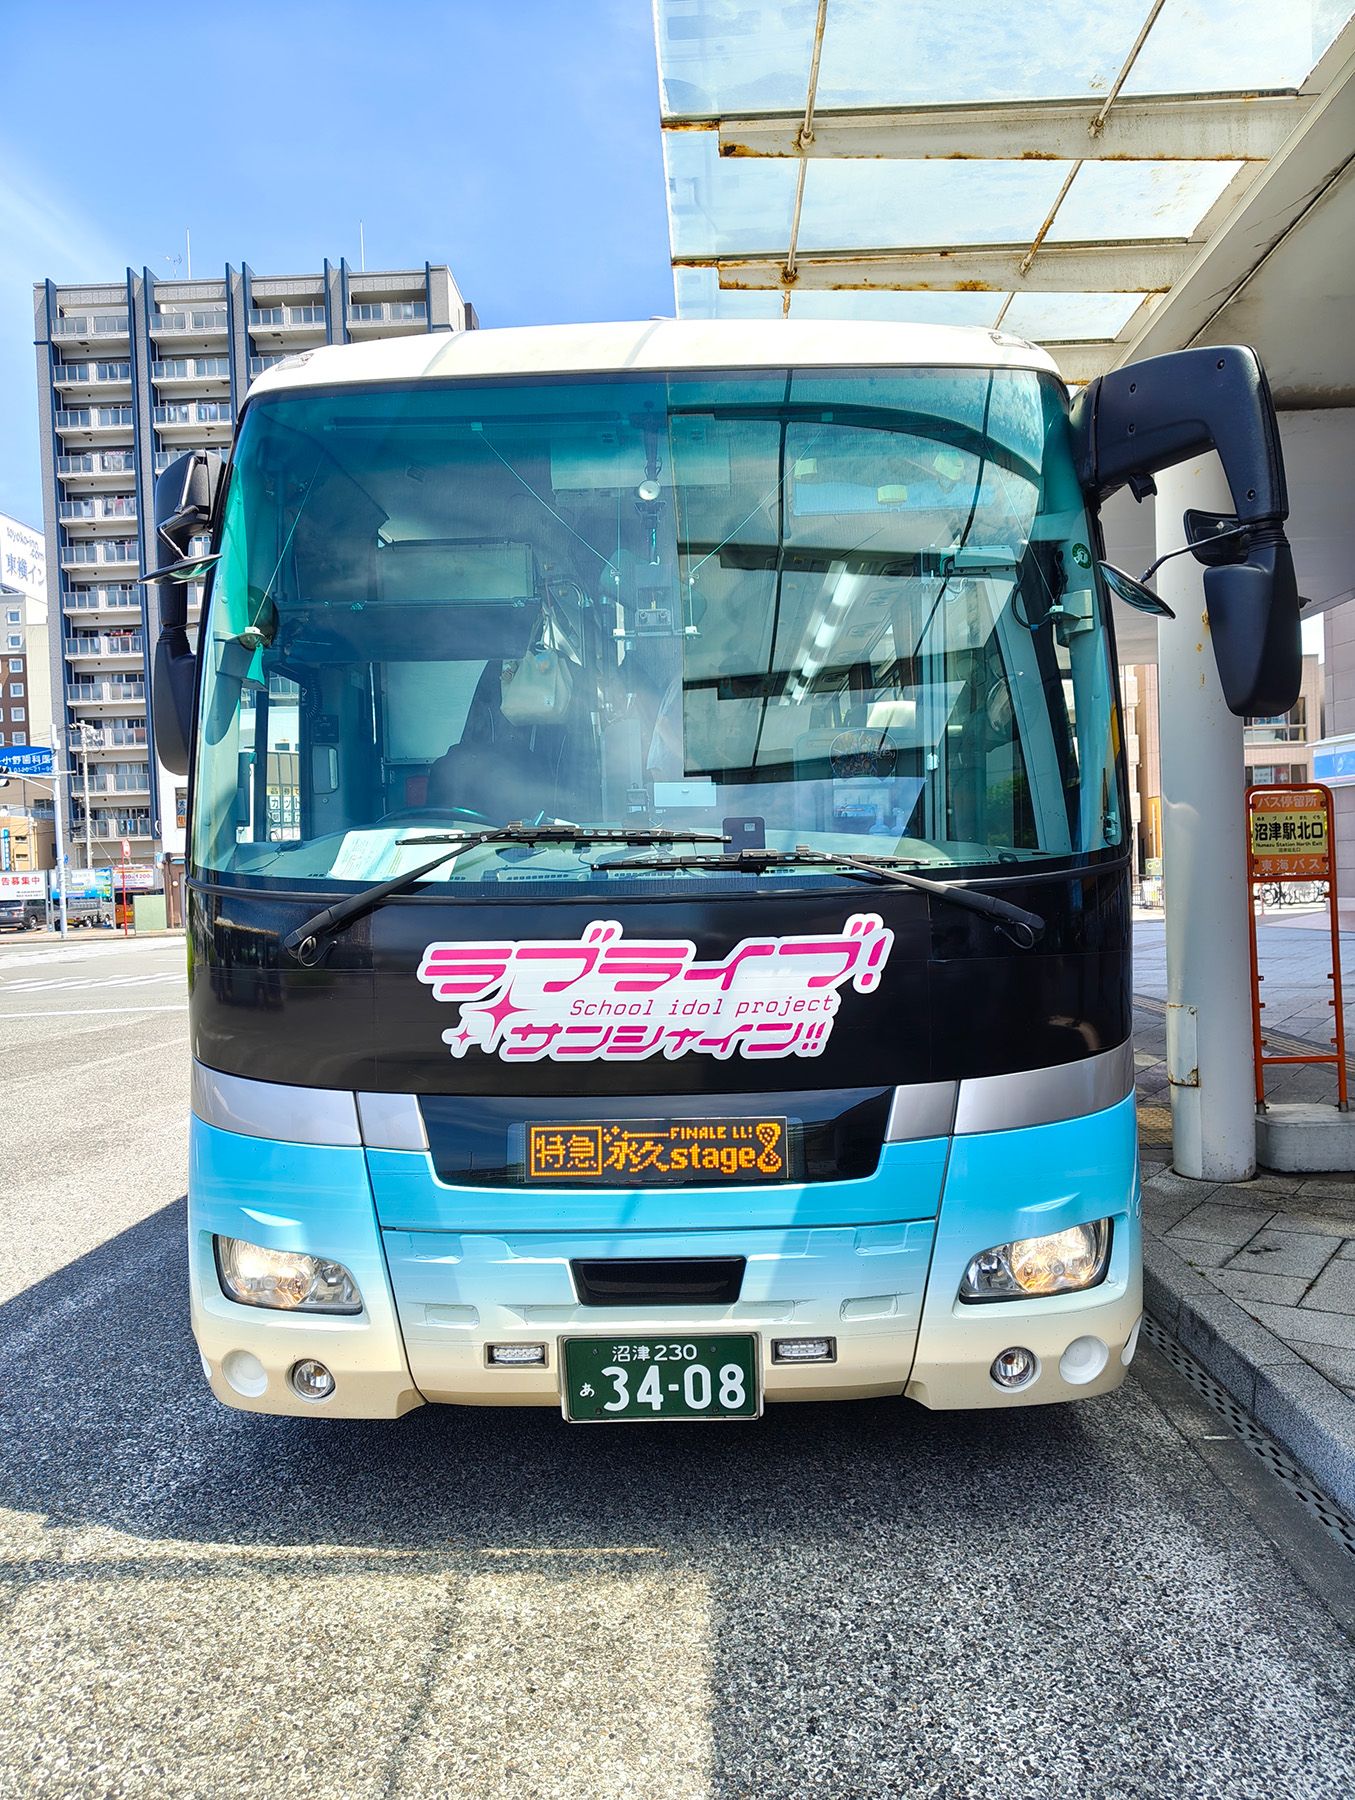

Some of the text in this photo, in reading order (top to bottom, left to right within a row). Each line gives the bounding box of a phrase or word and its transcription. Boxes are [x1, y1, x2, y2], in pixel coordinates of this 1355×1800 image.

[6, 553, 45, 586] 東横イン
[1257, 794, 1318, 808] バス停留所
[1255, 821, 1323, 841] 沼津駅北口
[1261, 858, 1321, 871] 東海バス
[569, 993, 834, 1022] School idol project
[670, 1125, 754, 1140] FINALE LL!
[536, 1134, 597, 1168] 特急
[579, 1363, 746, 1412] あ 34-08
